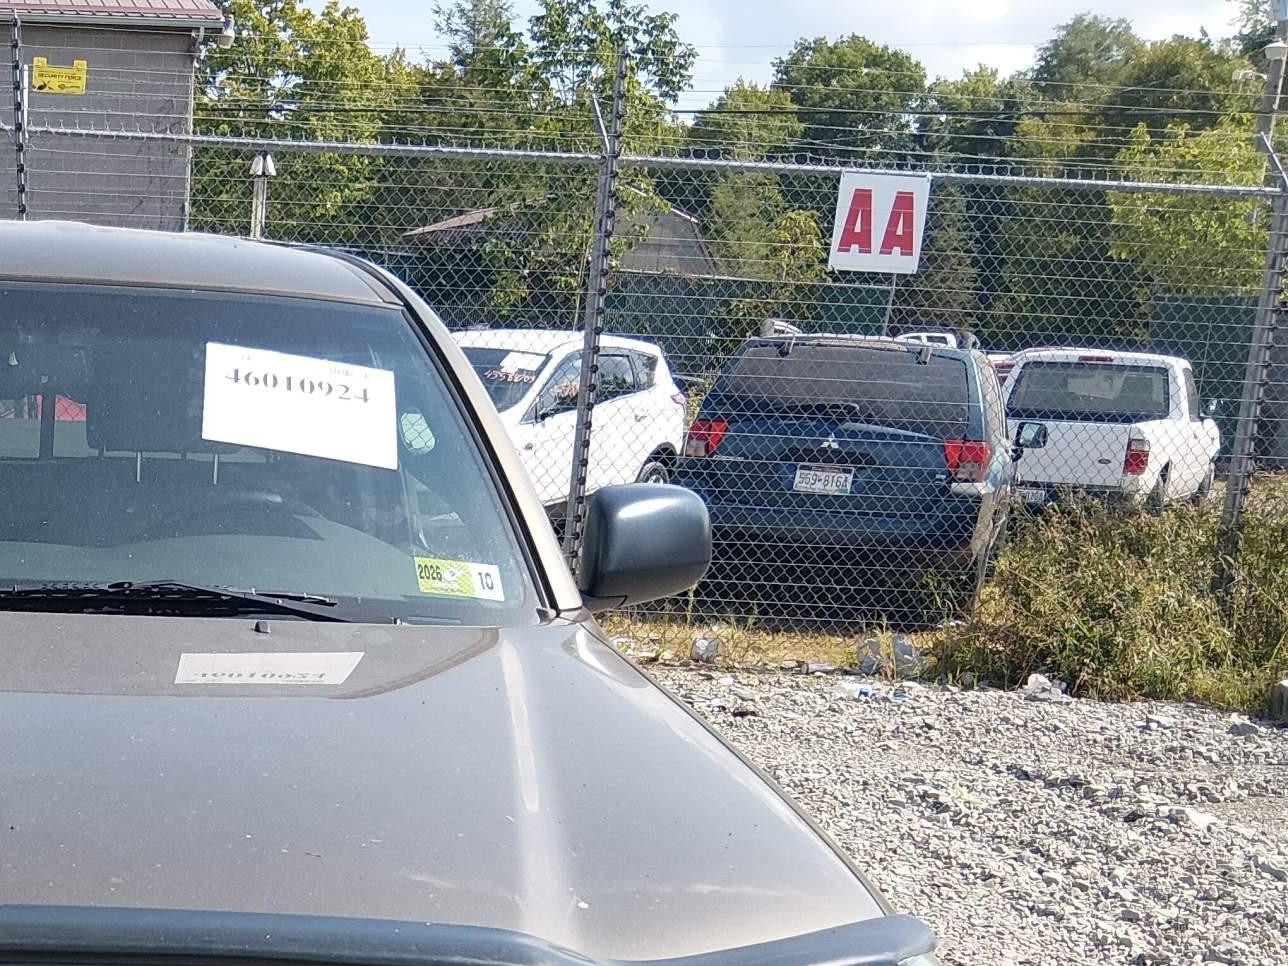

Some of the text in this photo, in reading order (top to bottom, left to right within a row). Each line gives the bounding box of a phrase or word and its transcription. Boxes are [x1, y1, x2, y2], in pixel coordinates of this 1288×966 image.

[837, 189, 914, 256] AA
[225, 368, 370, 403] 46010924
[418, 564, 443, 582] 2026
[478, 572, 494, 590] 10
